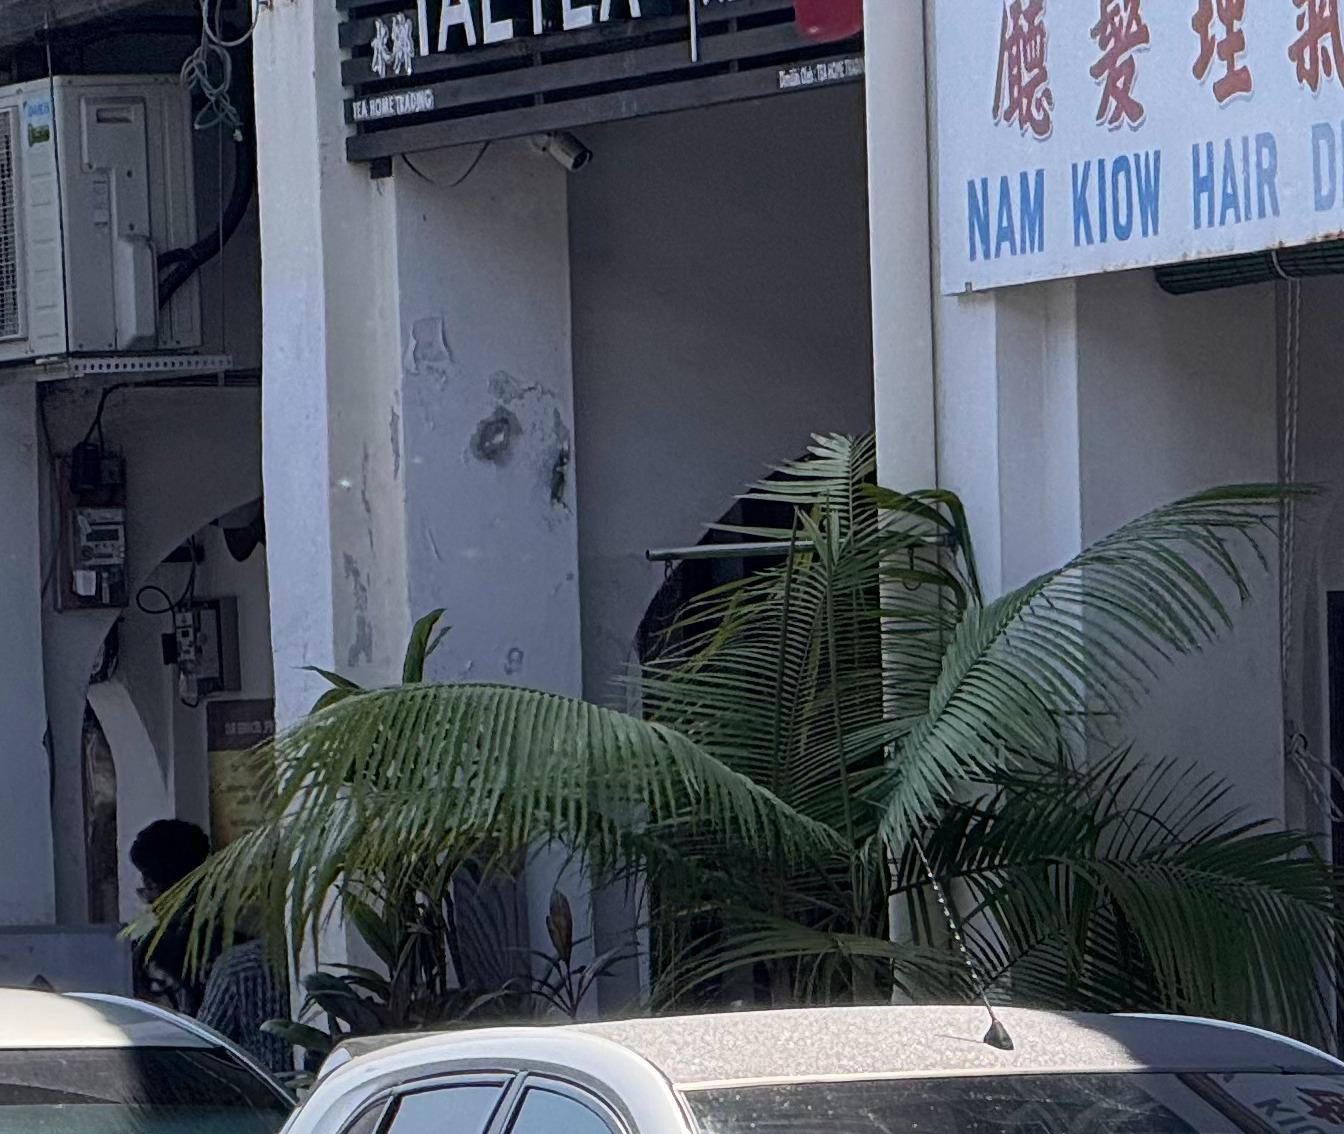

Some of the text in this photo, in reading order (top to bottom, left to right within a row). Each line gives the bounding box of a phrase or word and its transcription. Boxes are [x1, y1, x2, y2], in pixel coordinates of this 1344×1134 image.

[967, 168, 1045, 263] NAM
[1071, 150, 1162, 247] KIOW
[1192, 131, 1281, 230] HAIR
